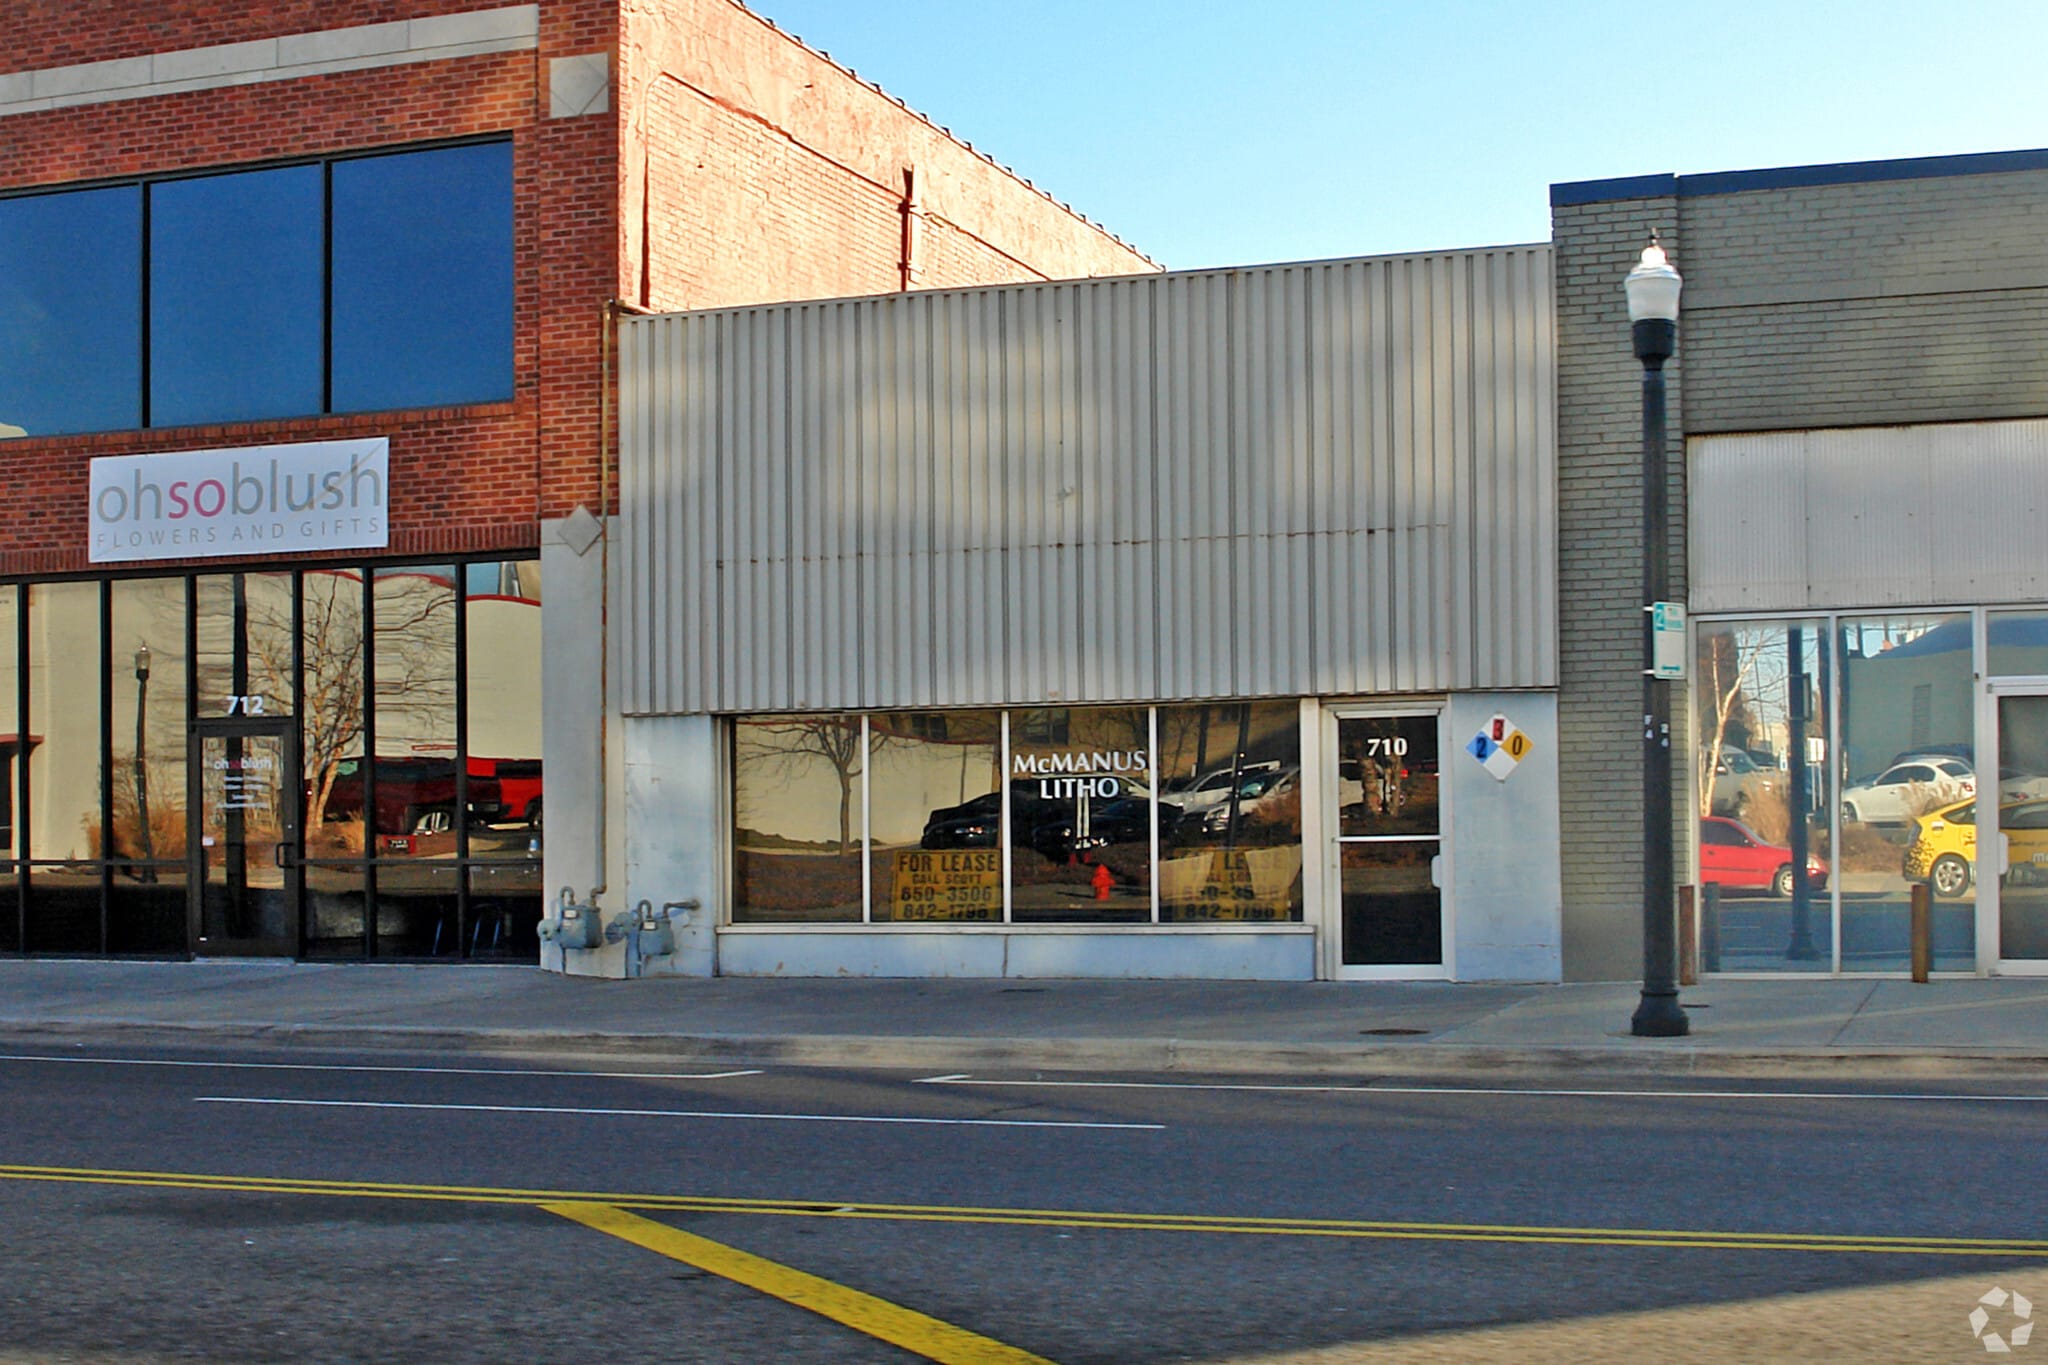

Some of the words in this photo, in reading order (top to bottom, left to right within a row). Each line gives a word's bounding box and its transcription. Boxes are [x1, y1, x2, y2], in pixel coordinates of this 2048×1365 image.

[96, 454, 381, 523] ohsoblush
[97, 526, 216, 549] FLOWERS
[232, 522, 284, 541] AND
[301, 517, 379, 537] GIFTS
[226, 695, 263, 715] 712
[1367, 738, 1408, 757] 710
[1476, 737, 1487, 759] 2
[1512, 735, 1522, 756] 0
[214, 757, 273, 770] ohblush
[1013, 750, 1147, 774] McMANUS
[1040, 777, 1119, 799] LITHO
[899, 854, 932, 872] FOR
[941, 854, 997, 872] LEASE
